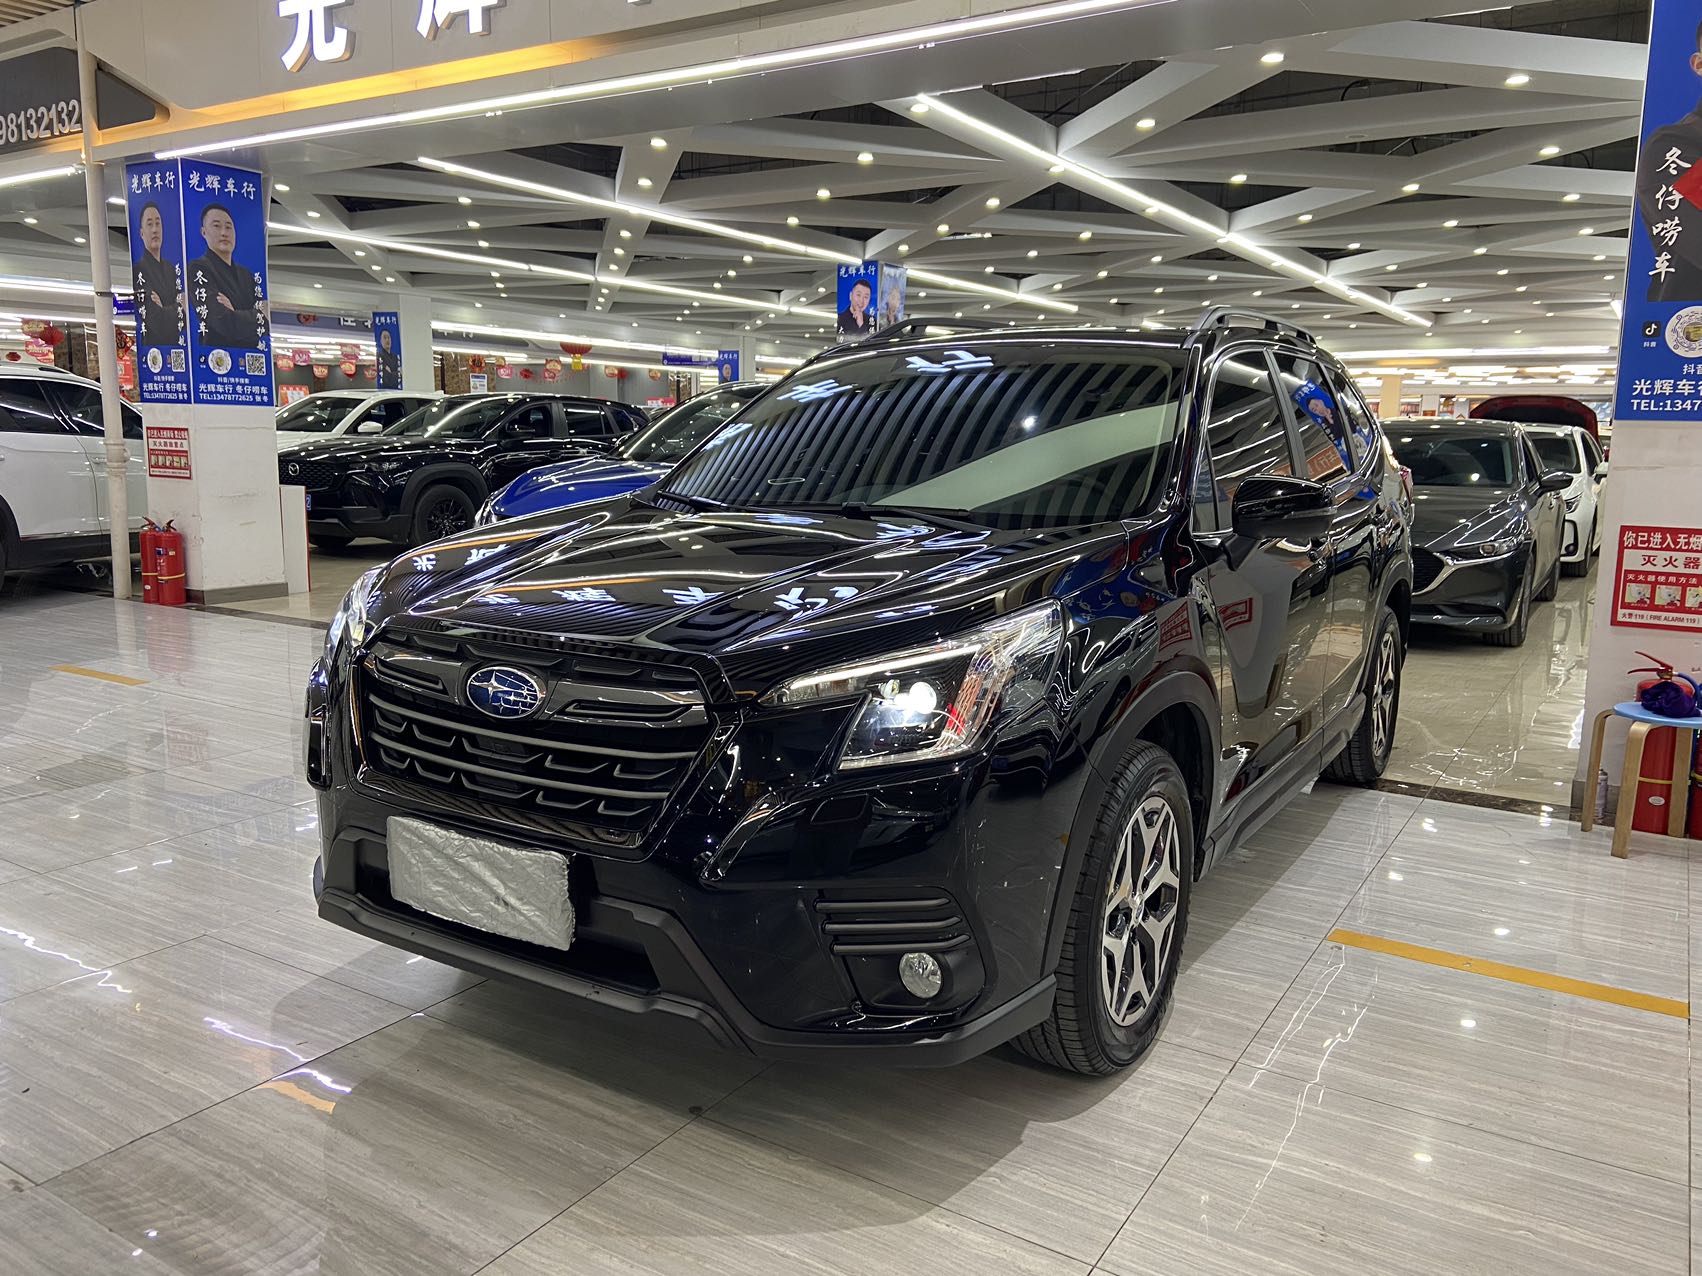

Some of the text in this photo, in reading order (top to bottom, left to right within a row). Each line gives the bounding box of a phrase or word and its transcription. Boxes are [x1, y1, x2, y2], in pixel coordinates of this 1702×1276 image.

[131, 171, 176, 194] 光辉车行
[188, 170, 257, 201] 光辉车行
[1648, 145, 1692, 284] 冬仔唠车
[193, 270, 209, 337] 冬仔唠车
[198, 383, 233, 394] 光辉车行
[1632, 378, 1702, 397] 光辉车
[1640, 554, 1702, 570] 灭火器
[1626, 573, 1699, 585] 灭火器使用方法
